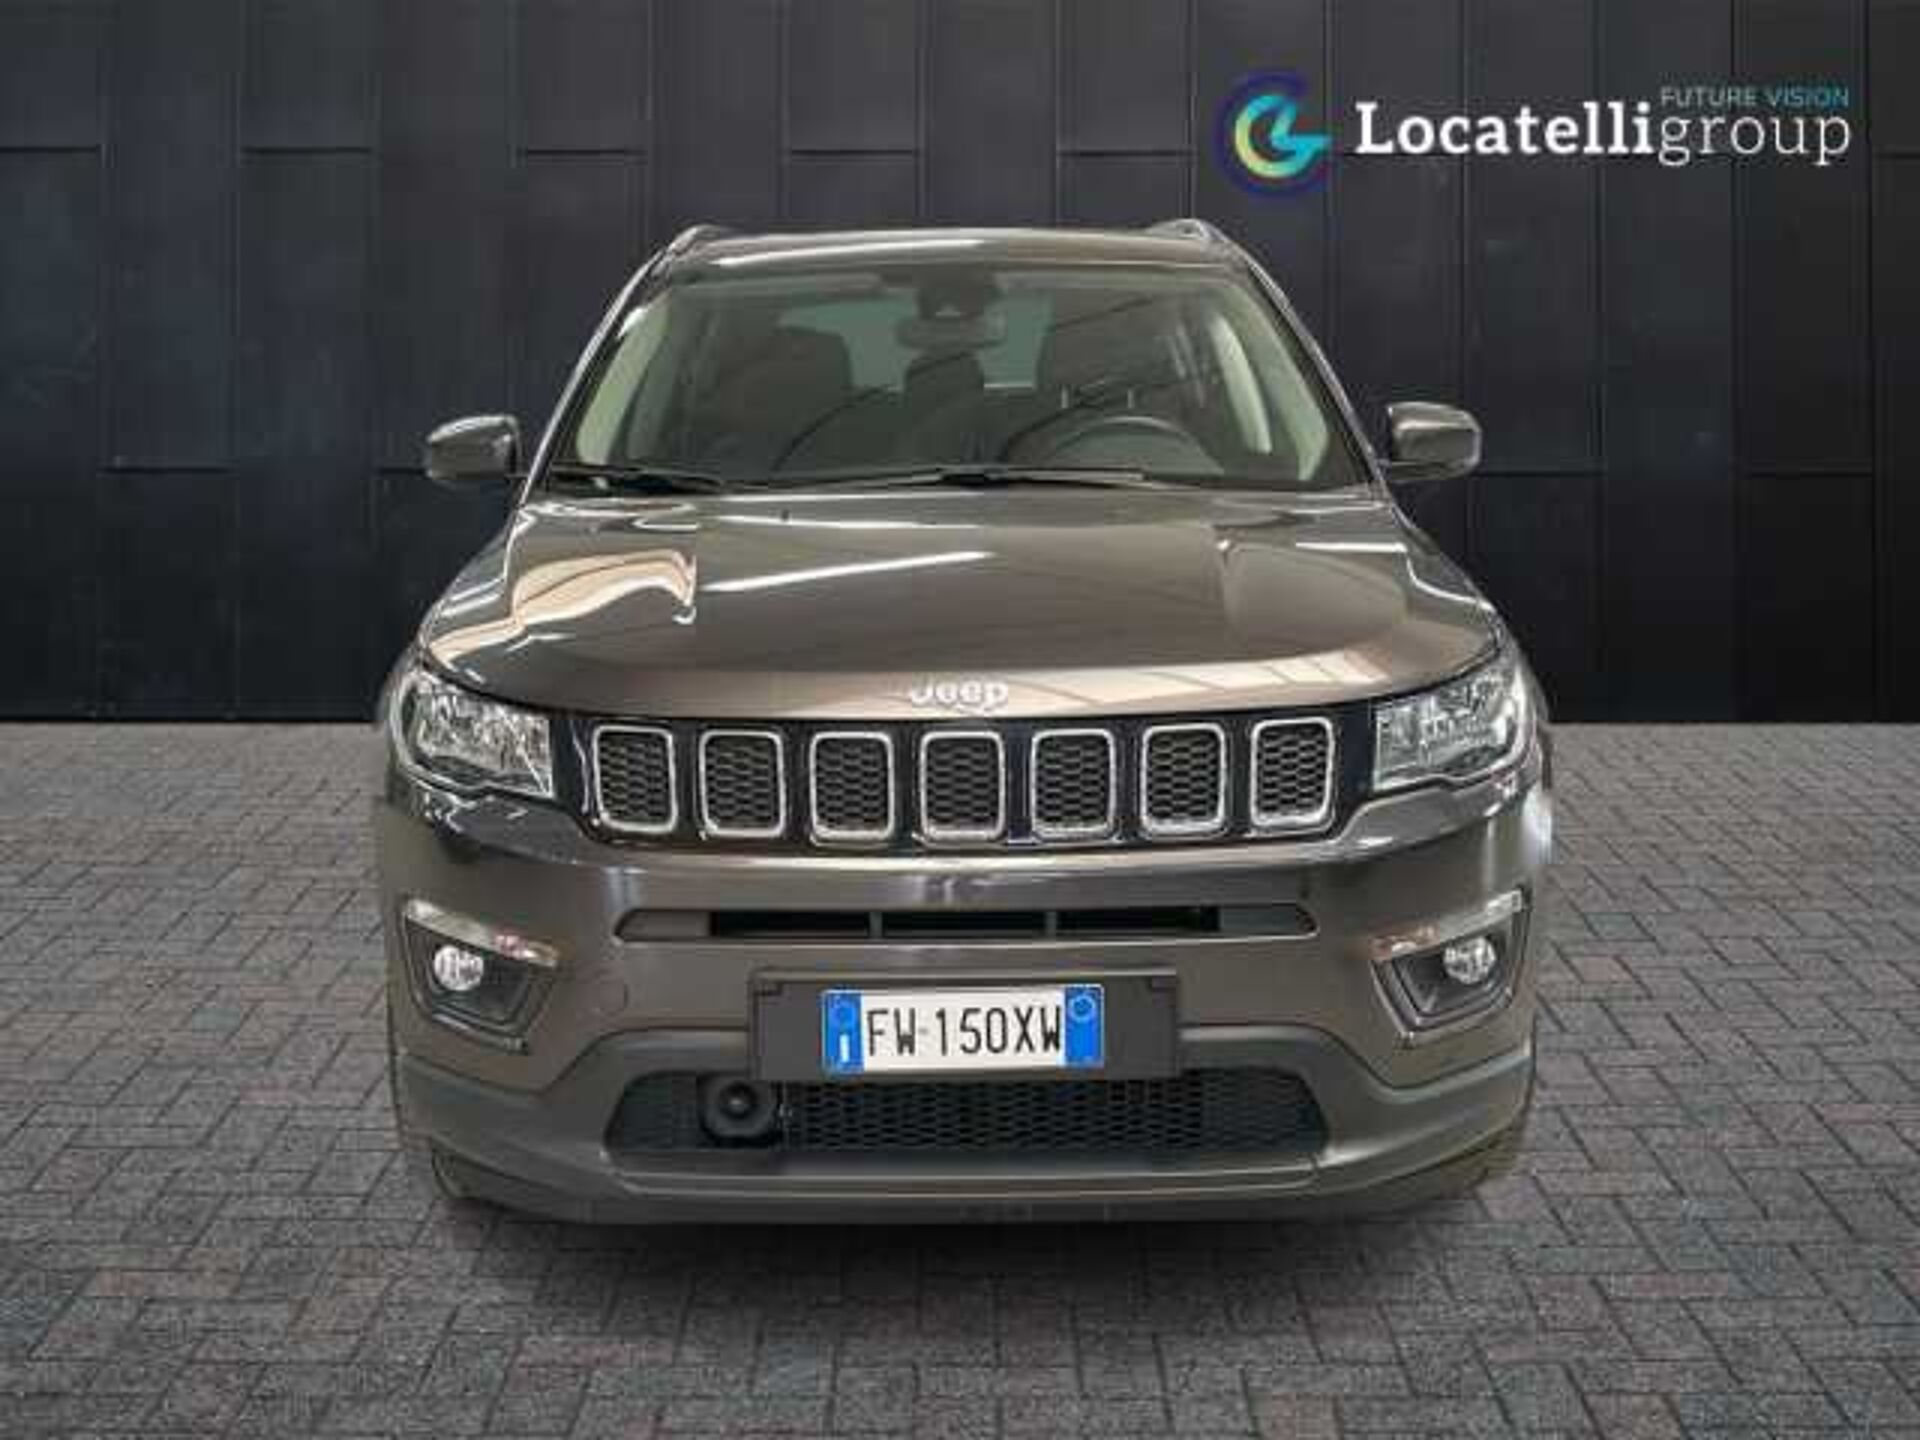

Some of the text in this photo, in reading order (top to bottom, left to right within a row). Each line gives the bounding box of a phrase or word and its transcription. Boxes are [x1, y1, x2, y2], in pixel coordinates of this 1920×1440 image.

[910, 678, 1009, 713] Jeep
[866, 1005, 1062, 1057] FW 150XW
